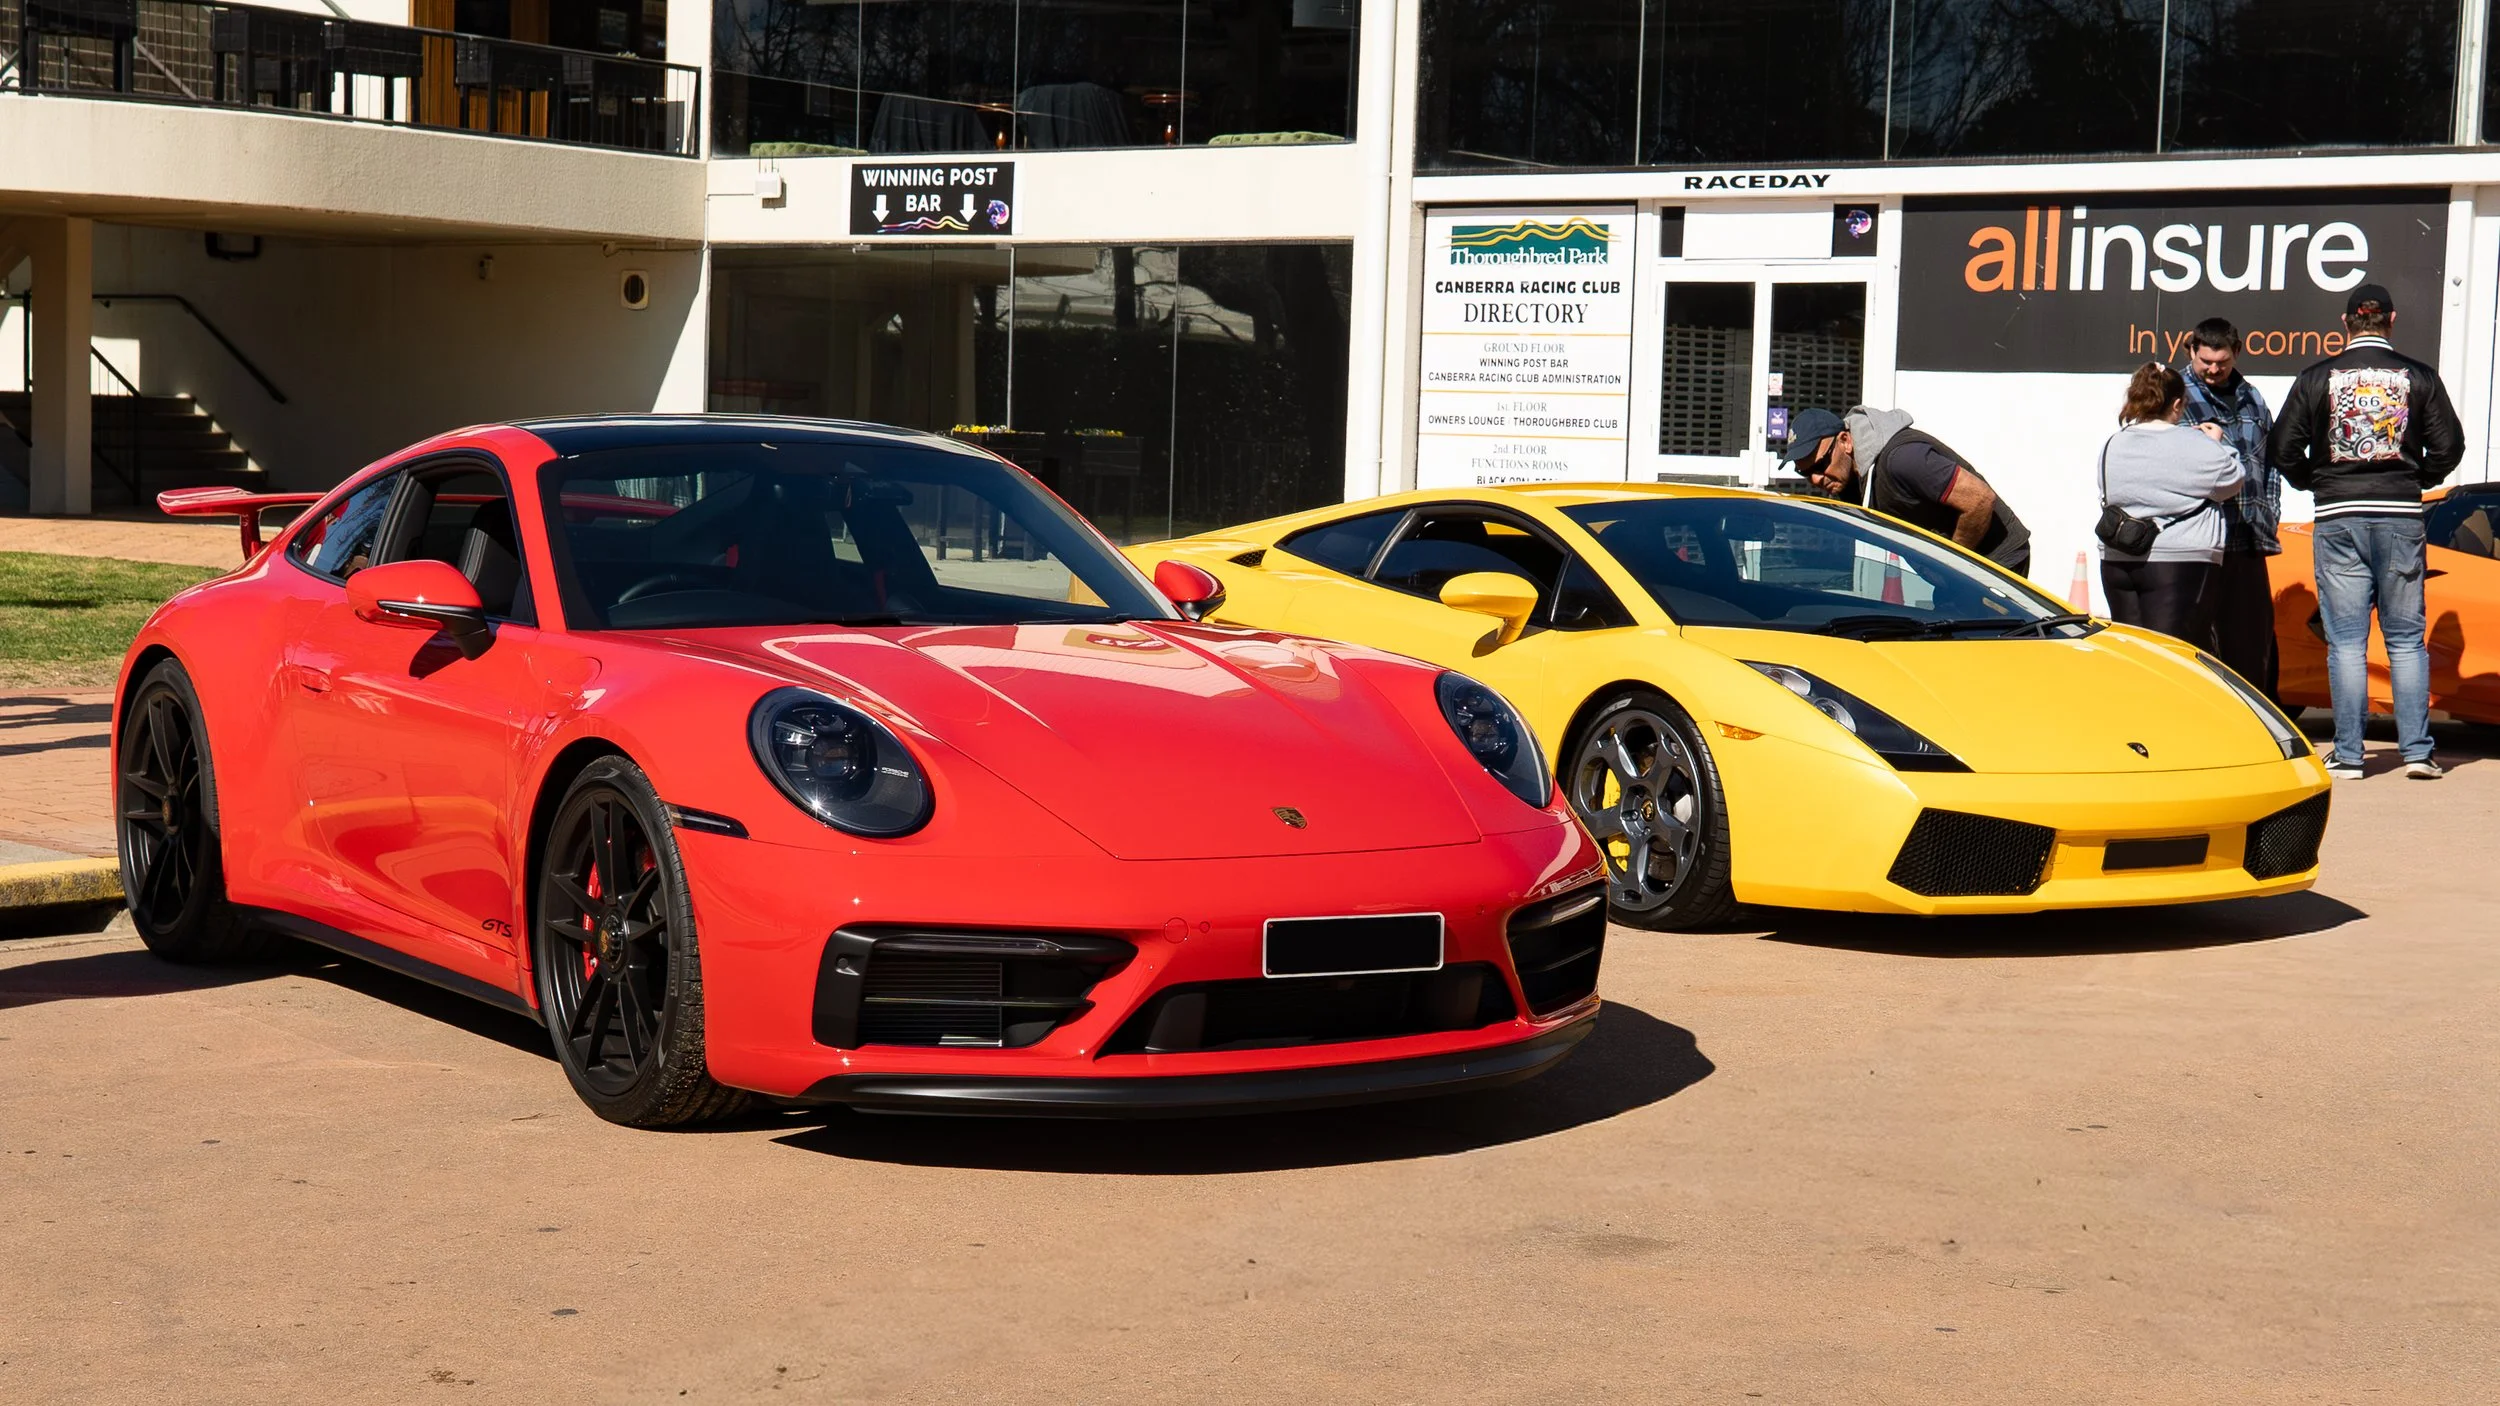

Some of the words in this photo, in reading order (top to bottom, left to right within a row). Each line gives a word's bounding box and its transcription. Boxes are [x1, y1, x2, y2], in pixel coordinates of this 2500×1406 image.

[862, 168, 945, 187] WINNING
[949, 167, 998, 186] POST
[1684, 174, 1831, 190] RACEDAY
[905, 194, 942, 212] BAR
[1451, 247, 1566, 266] Thoroughbred
[1567, 247, 1608, 265] Park
[1964, 205, 2369, 293] allinsure
[1435, 281, 1515, 294] CANBERRA
[1520, 280, 1576, 294] RACING
[1582, 280, 1621, 294] CLUB
[1463, 302, 1589, 324] DIRECTORY
[2128, 323, 2156, 354] In
[1483, 342, 1529, 353] GROUND
[1530, 342, 1566, 354] FLOOR
[1479, 358, 1520, 368] WINNING
[1523, 358, 1547, 369] POST
[1550, 358, 1569, 369] BAR
[1428, 371, 1476, 383] CANBERRA
[1479, 372, 1513, 383] RACING
[1515, 373, 1540, 384] CLUB
[1541, 373, 1622, 385] ADMINISTRATION
[1513, 401, 1548, 413] FLOOR
[2358, 396, 2381, 408] 66
[1428, 414, 1466, 425] OWNERS
[1468, 415, 1505, 426] LOUNGE
[1513, 416, 1591, 429] THOROUGHBRED
[1593, 418, 1619, 429] CLUB
[1513, 443, 1548, 456] FLOOR
[1471, 457, 1531, 470] FUNCTIONS
[1531, 459, 1569, 472] ROOMS
[481, 918, 513, 938] GTS
